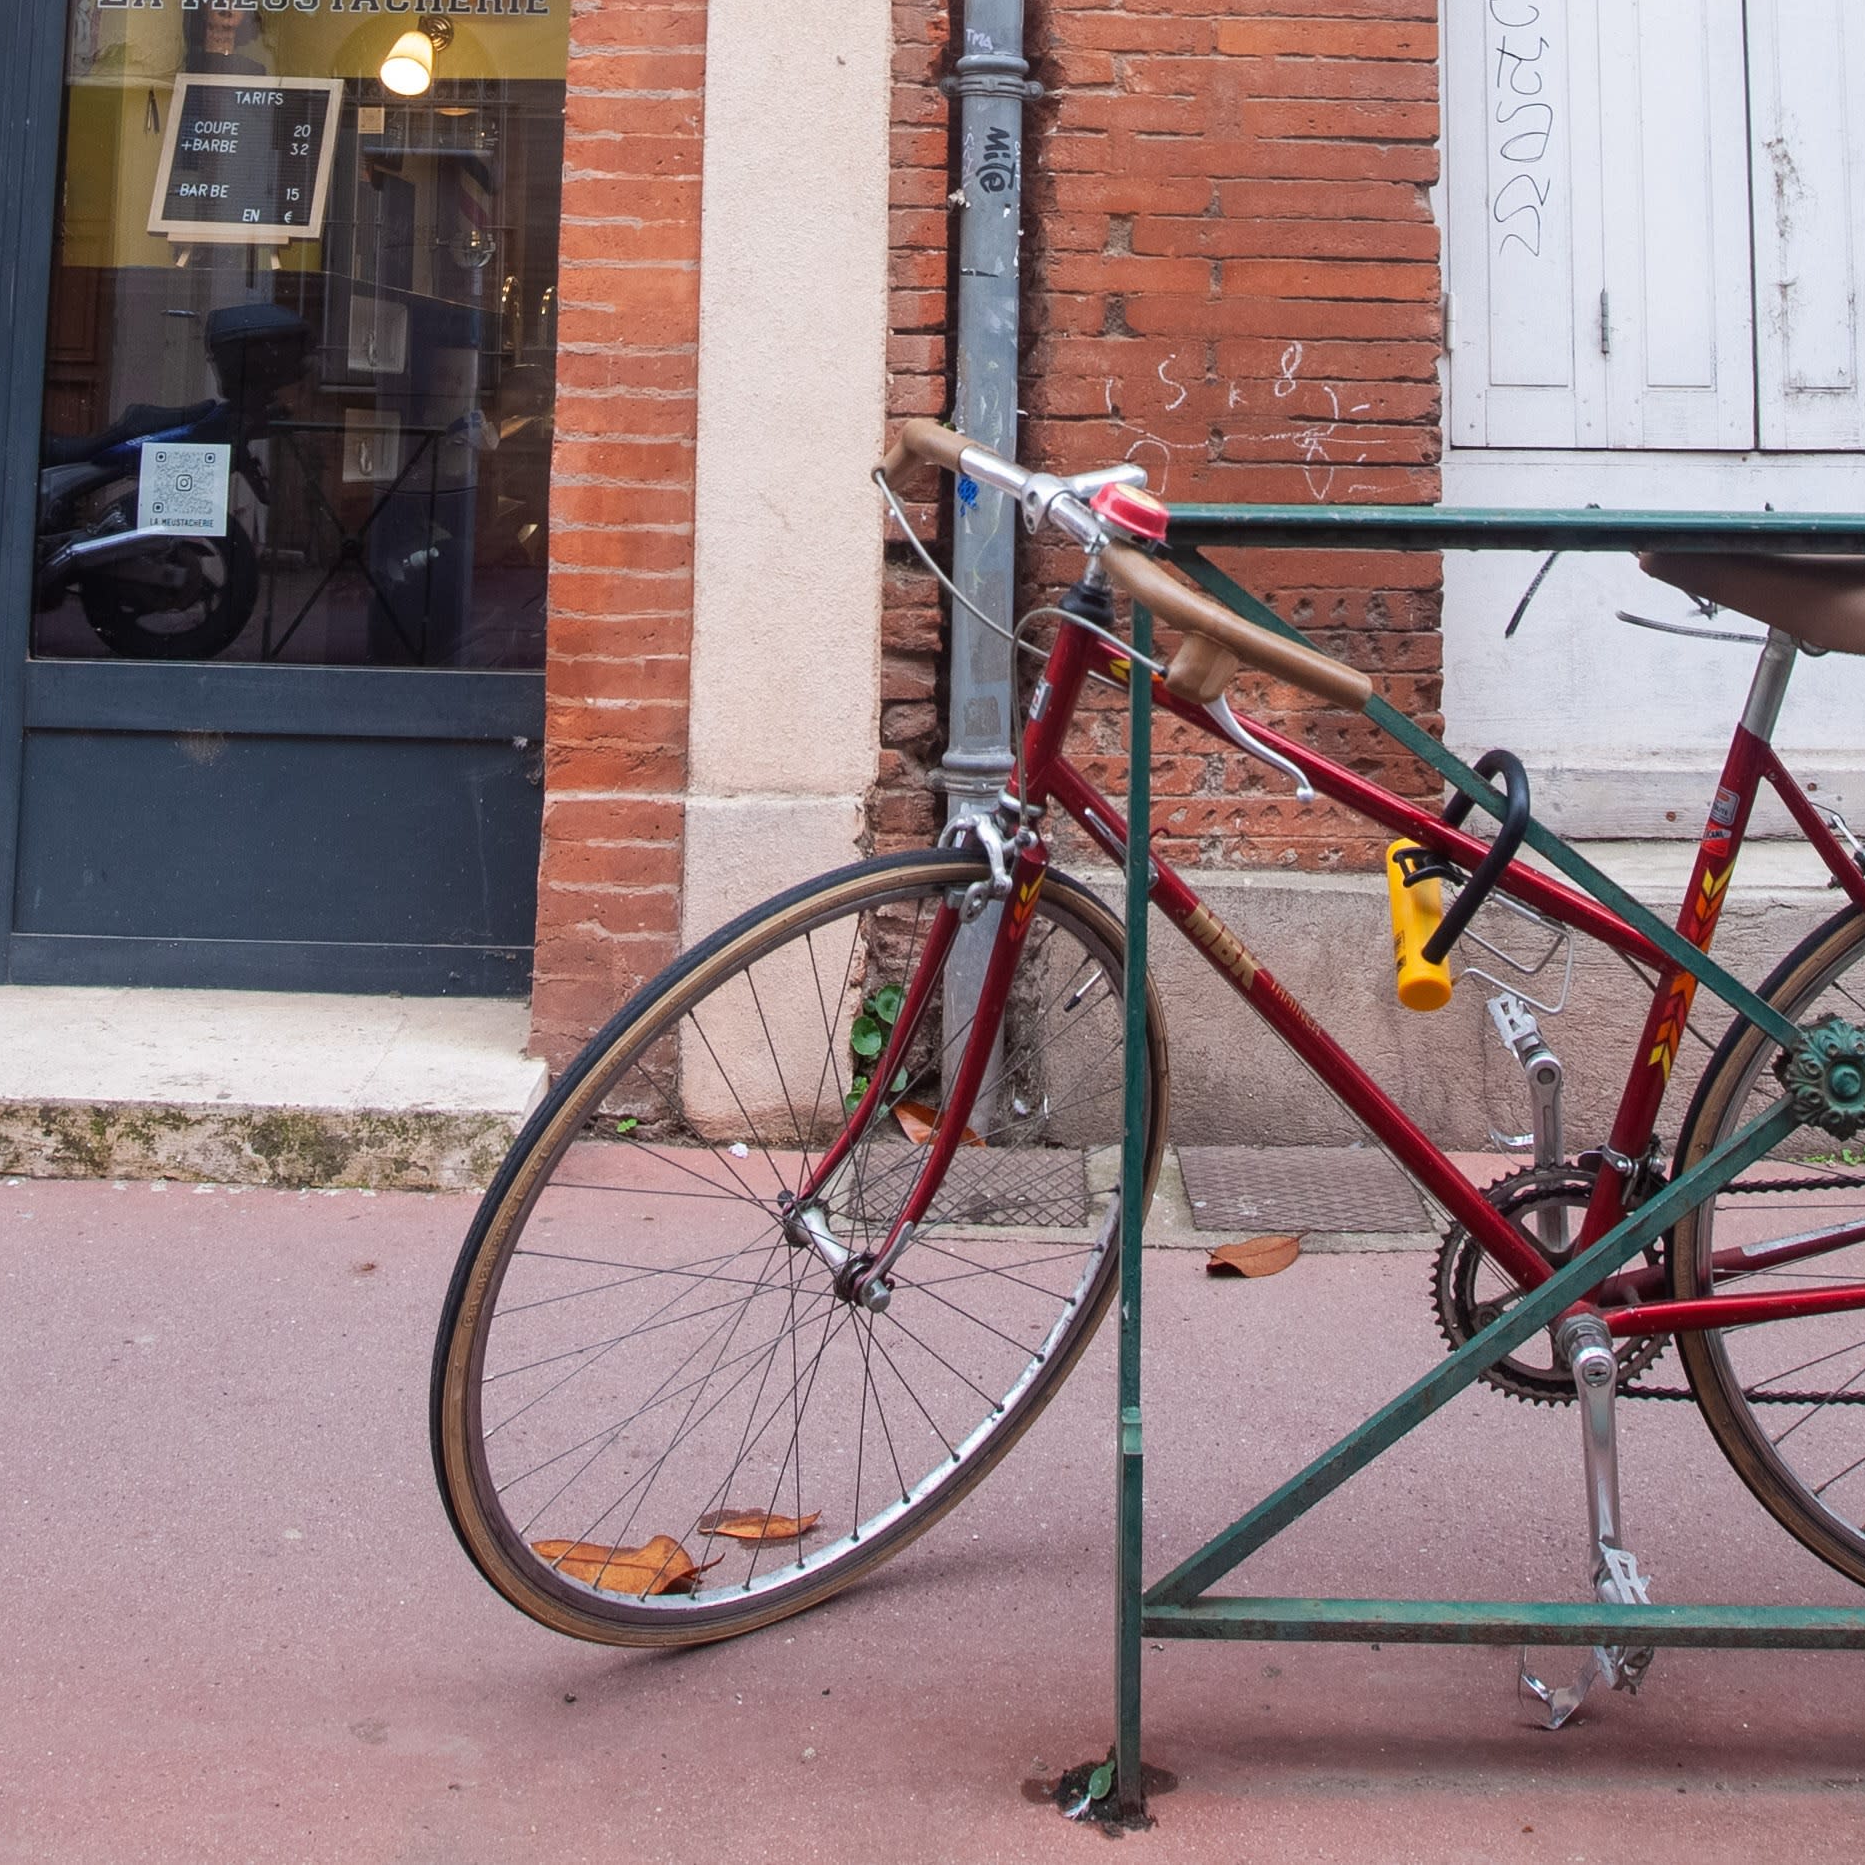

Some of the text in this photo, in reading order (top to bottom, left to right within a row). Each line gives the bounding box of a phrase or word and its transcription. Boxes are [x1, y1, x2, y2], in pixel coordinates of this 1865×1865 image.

[235, 91, 284, 106] TARIFS
[194, 121, 311, 138] COUPE 20
[181, 138, 309, 156] +BARBE 32
[286, 187, 300, 201] 15
[242, 208, 293, 224] EN €
[150, 518, 214, 528] LA MEUSTACHERIE
[1184, 902, 1264, 991] MBK
